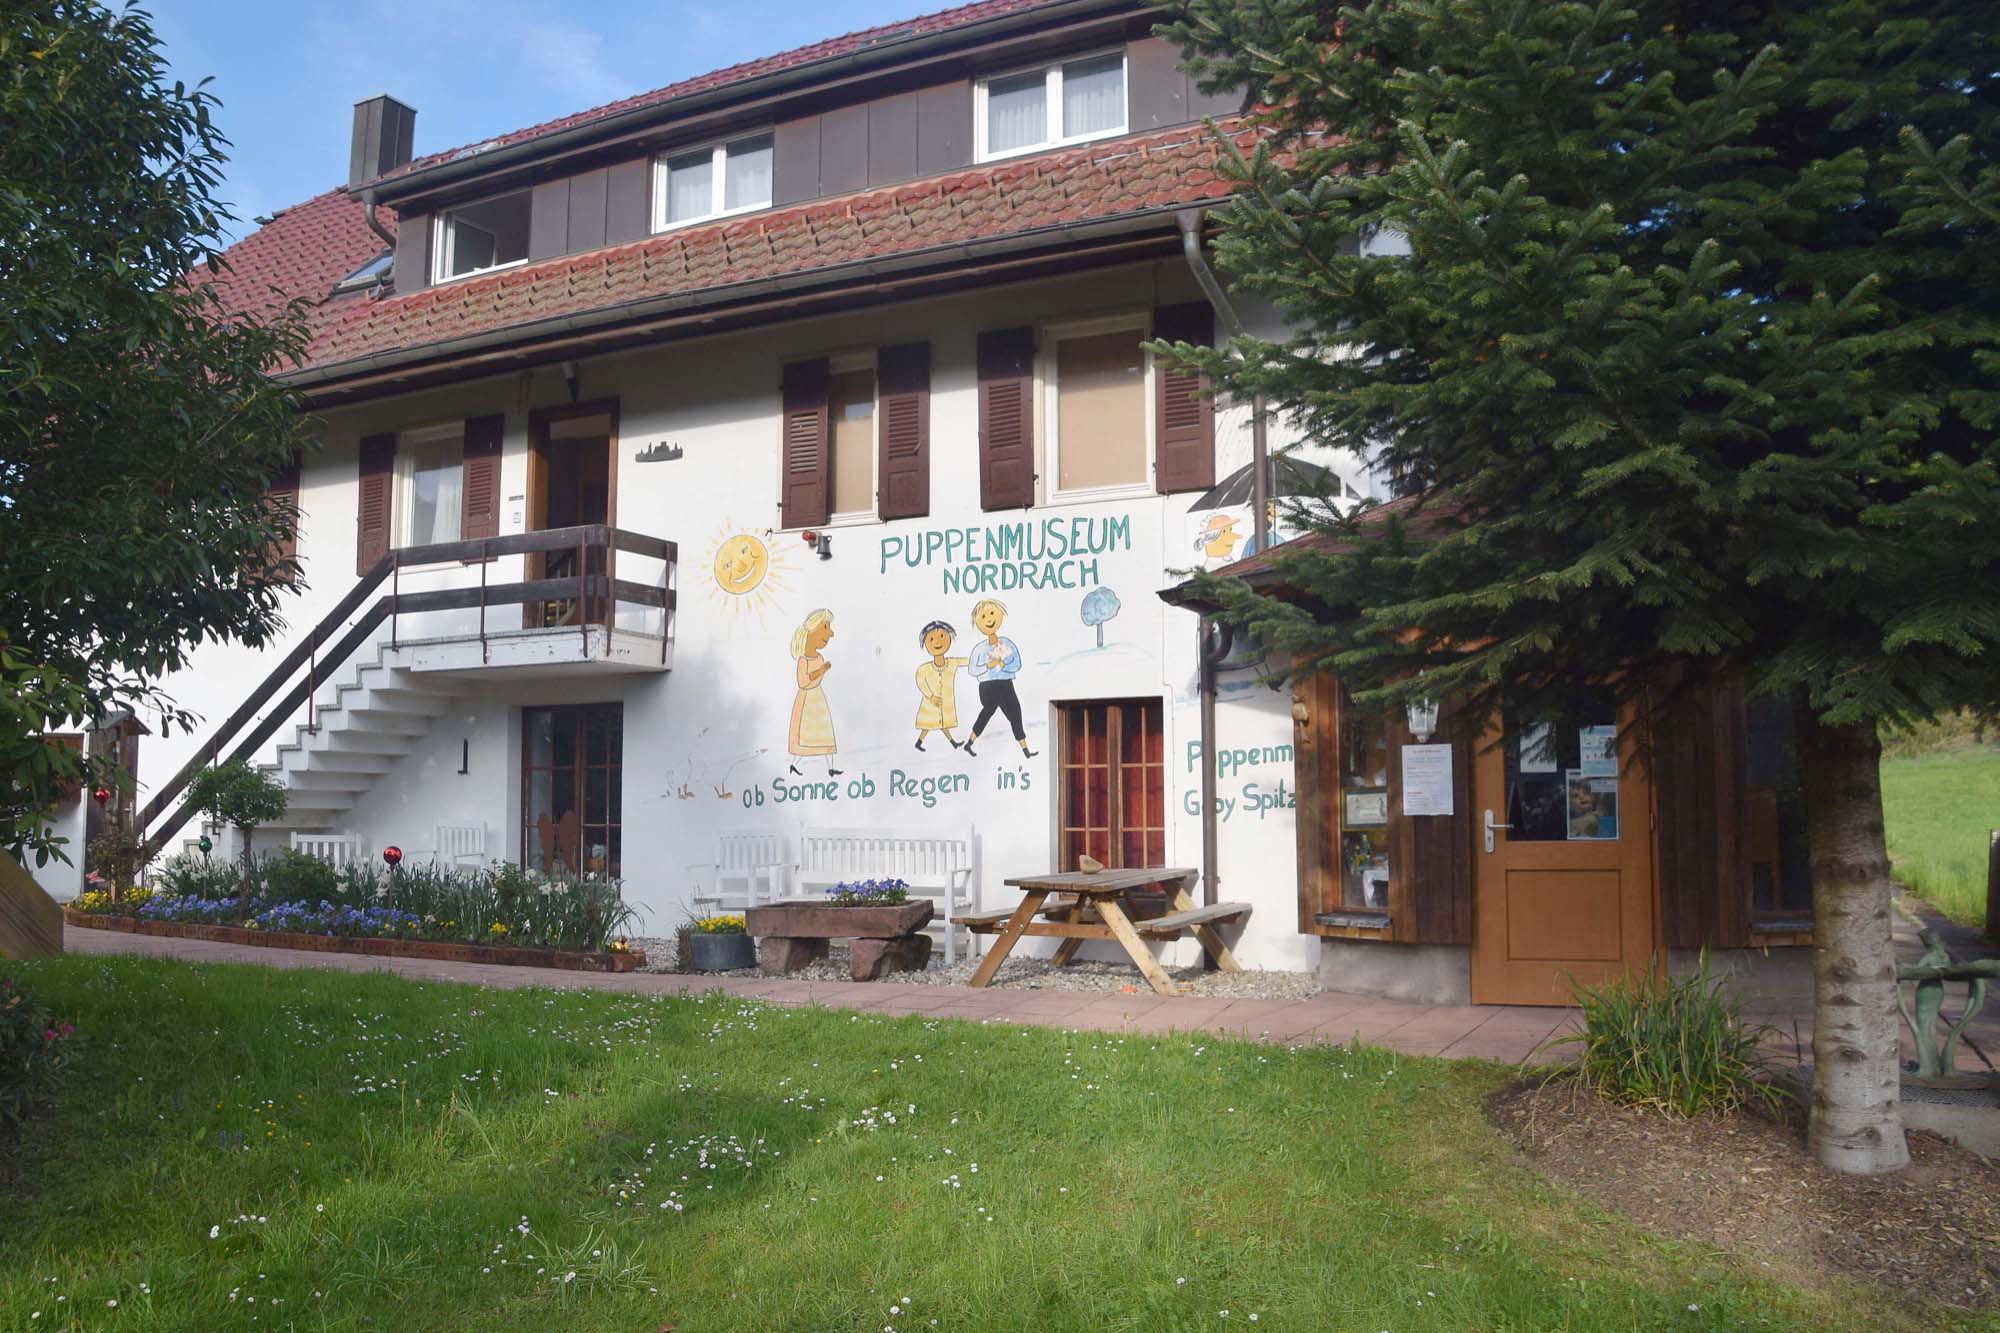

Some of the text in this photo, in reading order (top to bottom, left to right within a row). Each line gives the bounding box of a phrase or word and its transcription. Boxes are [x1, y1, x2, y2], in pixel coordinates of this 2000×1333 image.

[881, 514, 1131, 574] PUPPENMUSEUM
[943, 559, 1100, 594] NORDRACH
[1187, 740, 1294, 778] Pppenm
[743, 766, 1032, 808] ob Sonne ob Regen in's
[1184, 790, 1236, 822] Gy
